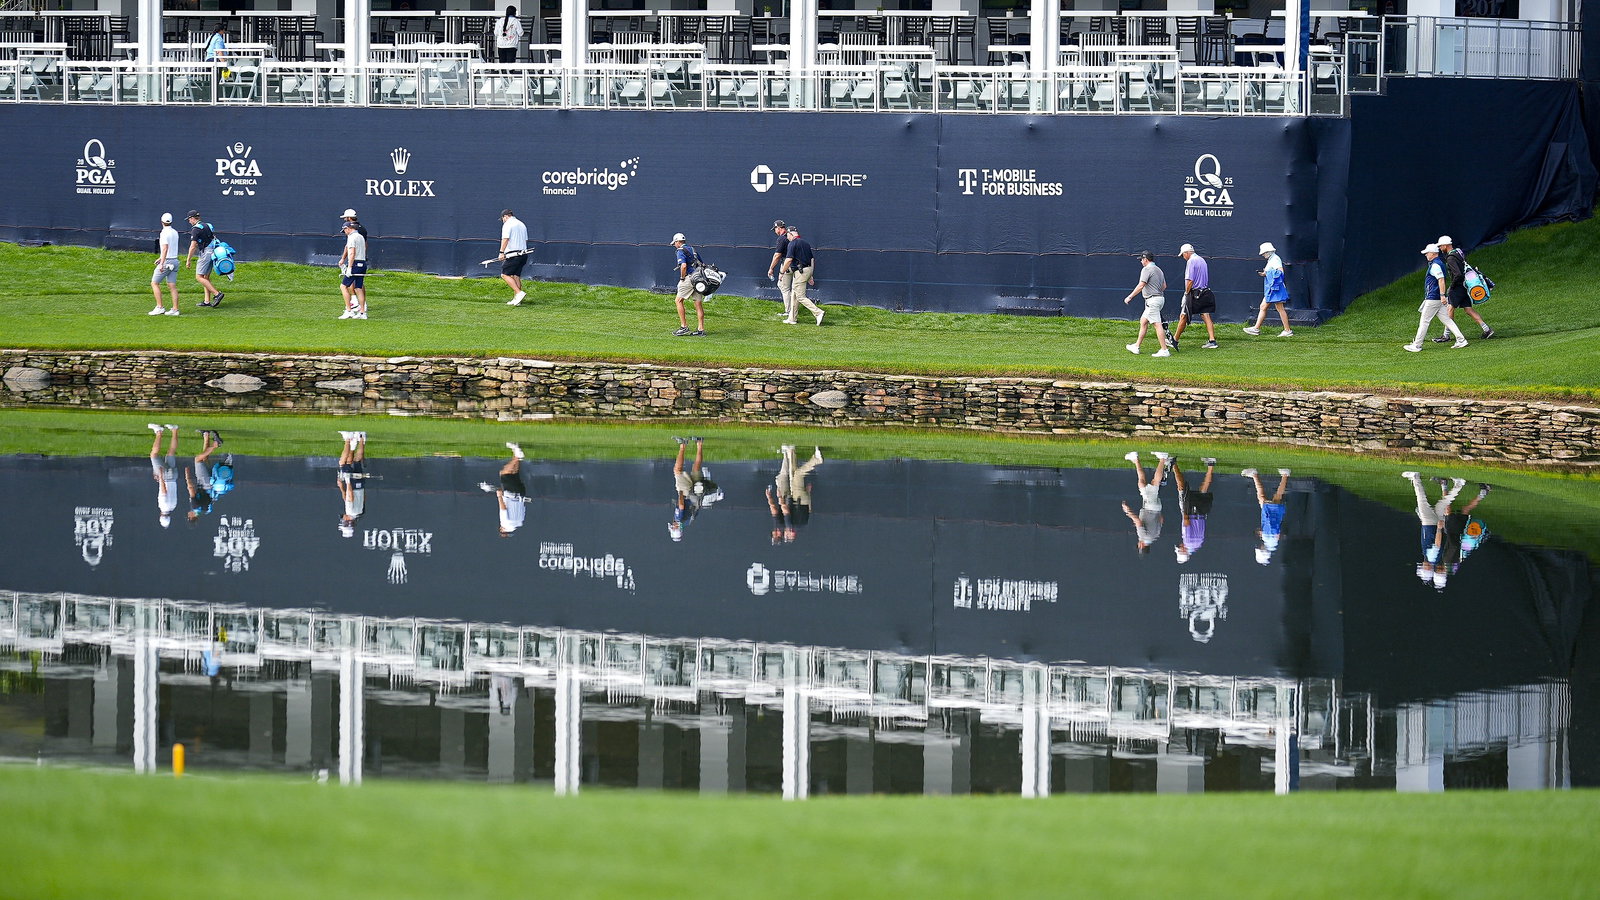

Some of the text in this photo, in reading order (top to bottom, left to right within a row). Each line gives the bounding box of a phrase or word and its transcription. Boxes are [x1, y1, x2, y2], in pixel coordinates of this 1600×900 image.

[216, 158, 262, 177] PGA
[75, 168, 116, 185] PGA
[230, 178, 258, 186] AMERICA
[541, 167, 628, 191] corebridge
[982, 169, 1036, 182] T-MOBILE
[1185, 176, 1194, 184] 20
[76, 187, 115, 195] QUAIL HOLLOW
[365, 179, 435, 197] ROLEX
[543, 186, 577, 196] financial
[982, 182, 1063, 196] FOR BUSINESS
[1184, 187, 1234, 205] PGA
[1184, 208, 1233, 217] QUAIL HOLLOW
